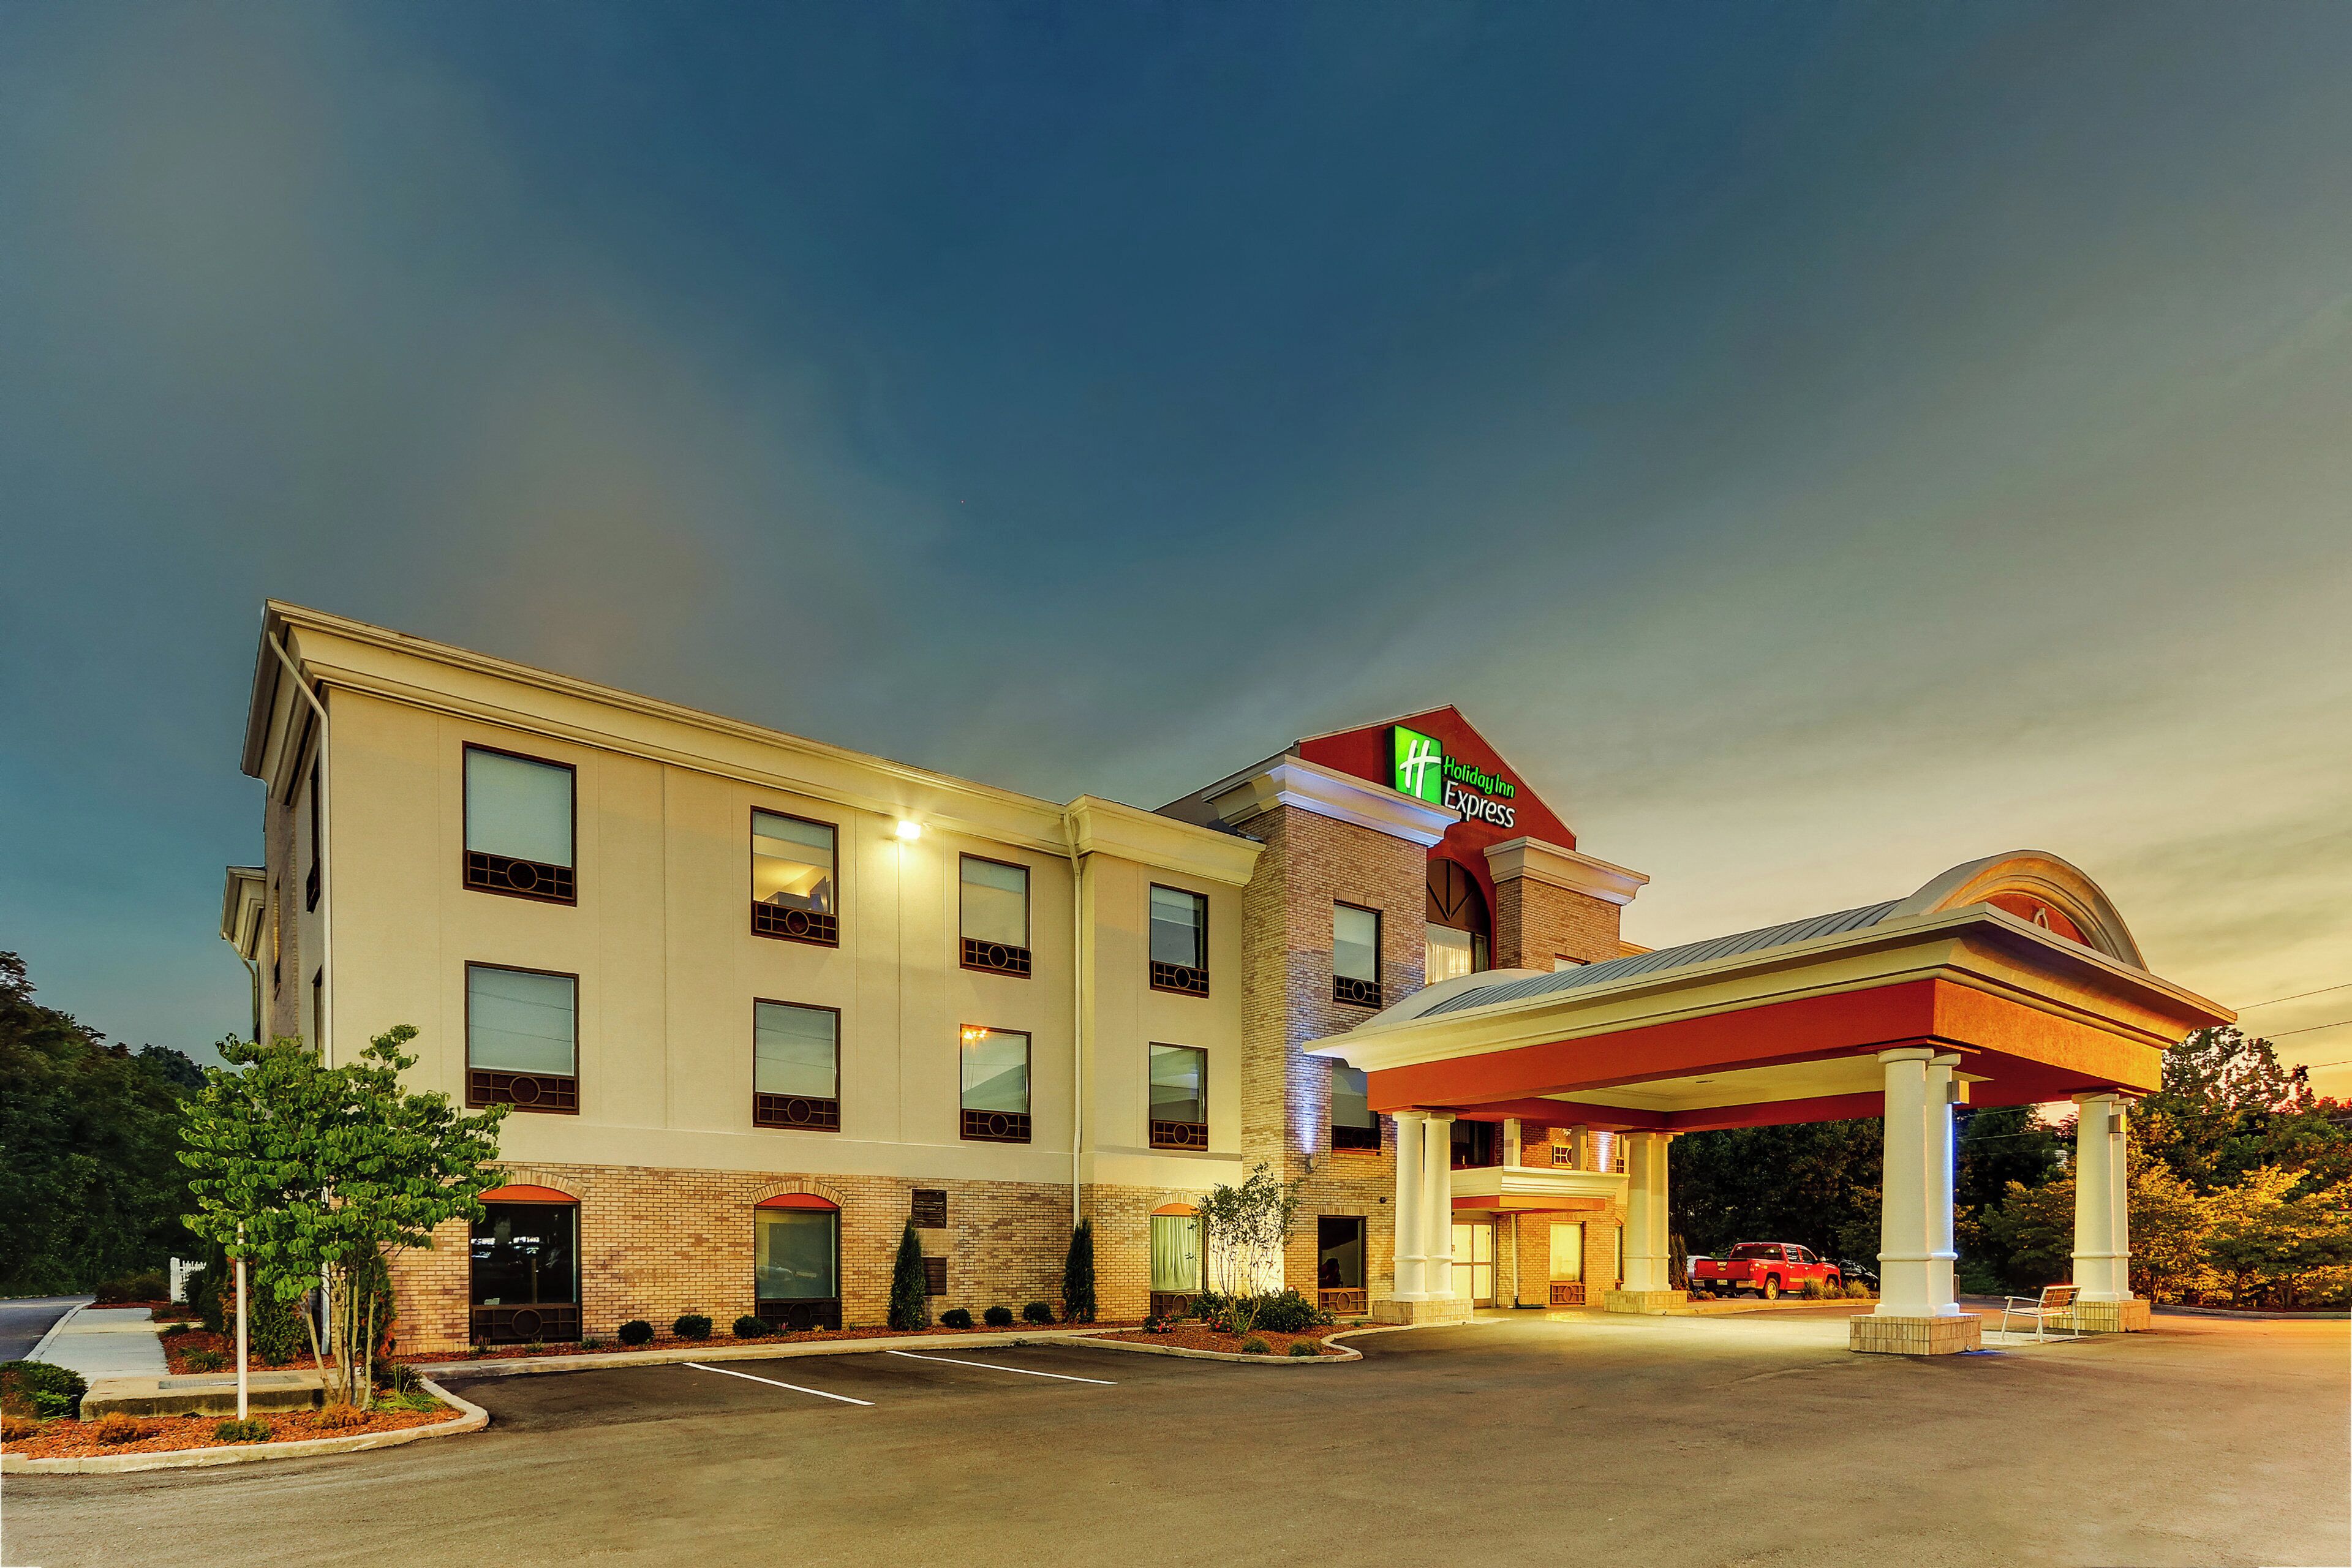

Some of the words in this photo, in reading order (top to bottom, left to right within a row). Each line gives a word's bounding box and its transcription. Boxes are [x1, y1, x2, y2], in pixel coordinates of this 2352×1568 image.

[1443, 755, 1494, 794] Holiday
[1495, 774, 1514, 798] Inn
[1444, 780, 1515, 828] Express
